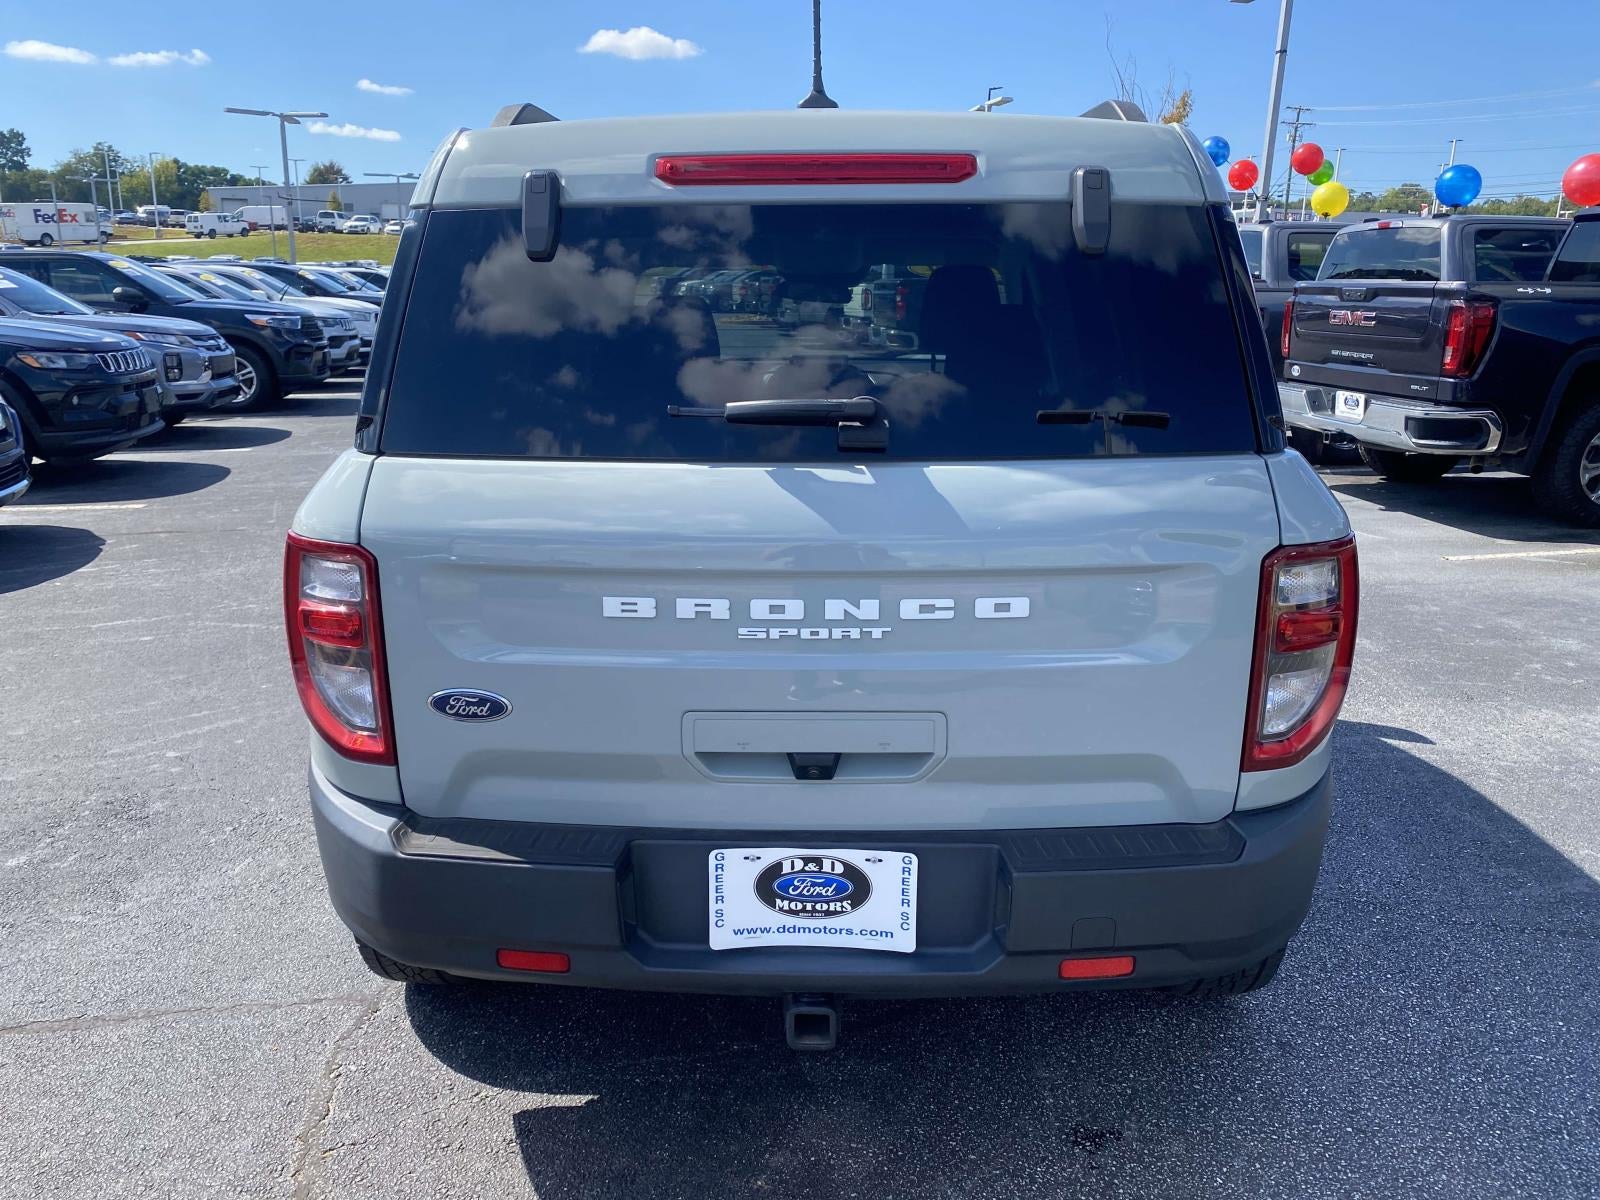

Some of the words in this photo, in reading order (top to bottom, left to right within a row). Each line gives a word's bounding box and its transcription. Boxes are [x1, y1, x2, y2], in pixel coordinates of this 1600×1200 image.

[32, 208, 79, 224] FedEx
[1328, 309, 1376, 327] GMC
[1331, 349, 1374, 359] SIERRA
[602, 597, 1030, 620] BRONCO
[737, 627, 892, 639] SPORT
[446, 695, 491, 716] Ford
[780, 857, 845, 875] D&D
[788, 877, 837, 898] Ford
[775, 898, 852, 912] MOTORS
[732, 924, 895, 939] www.ddmotors.com
